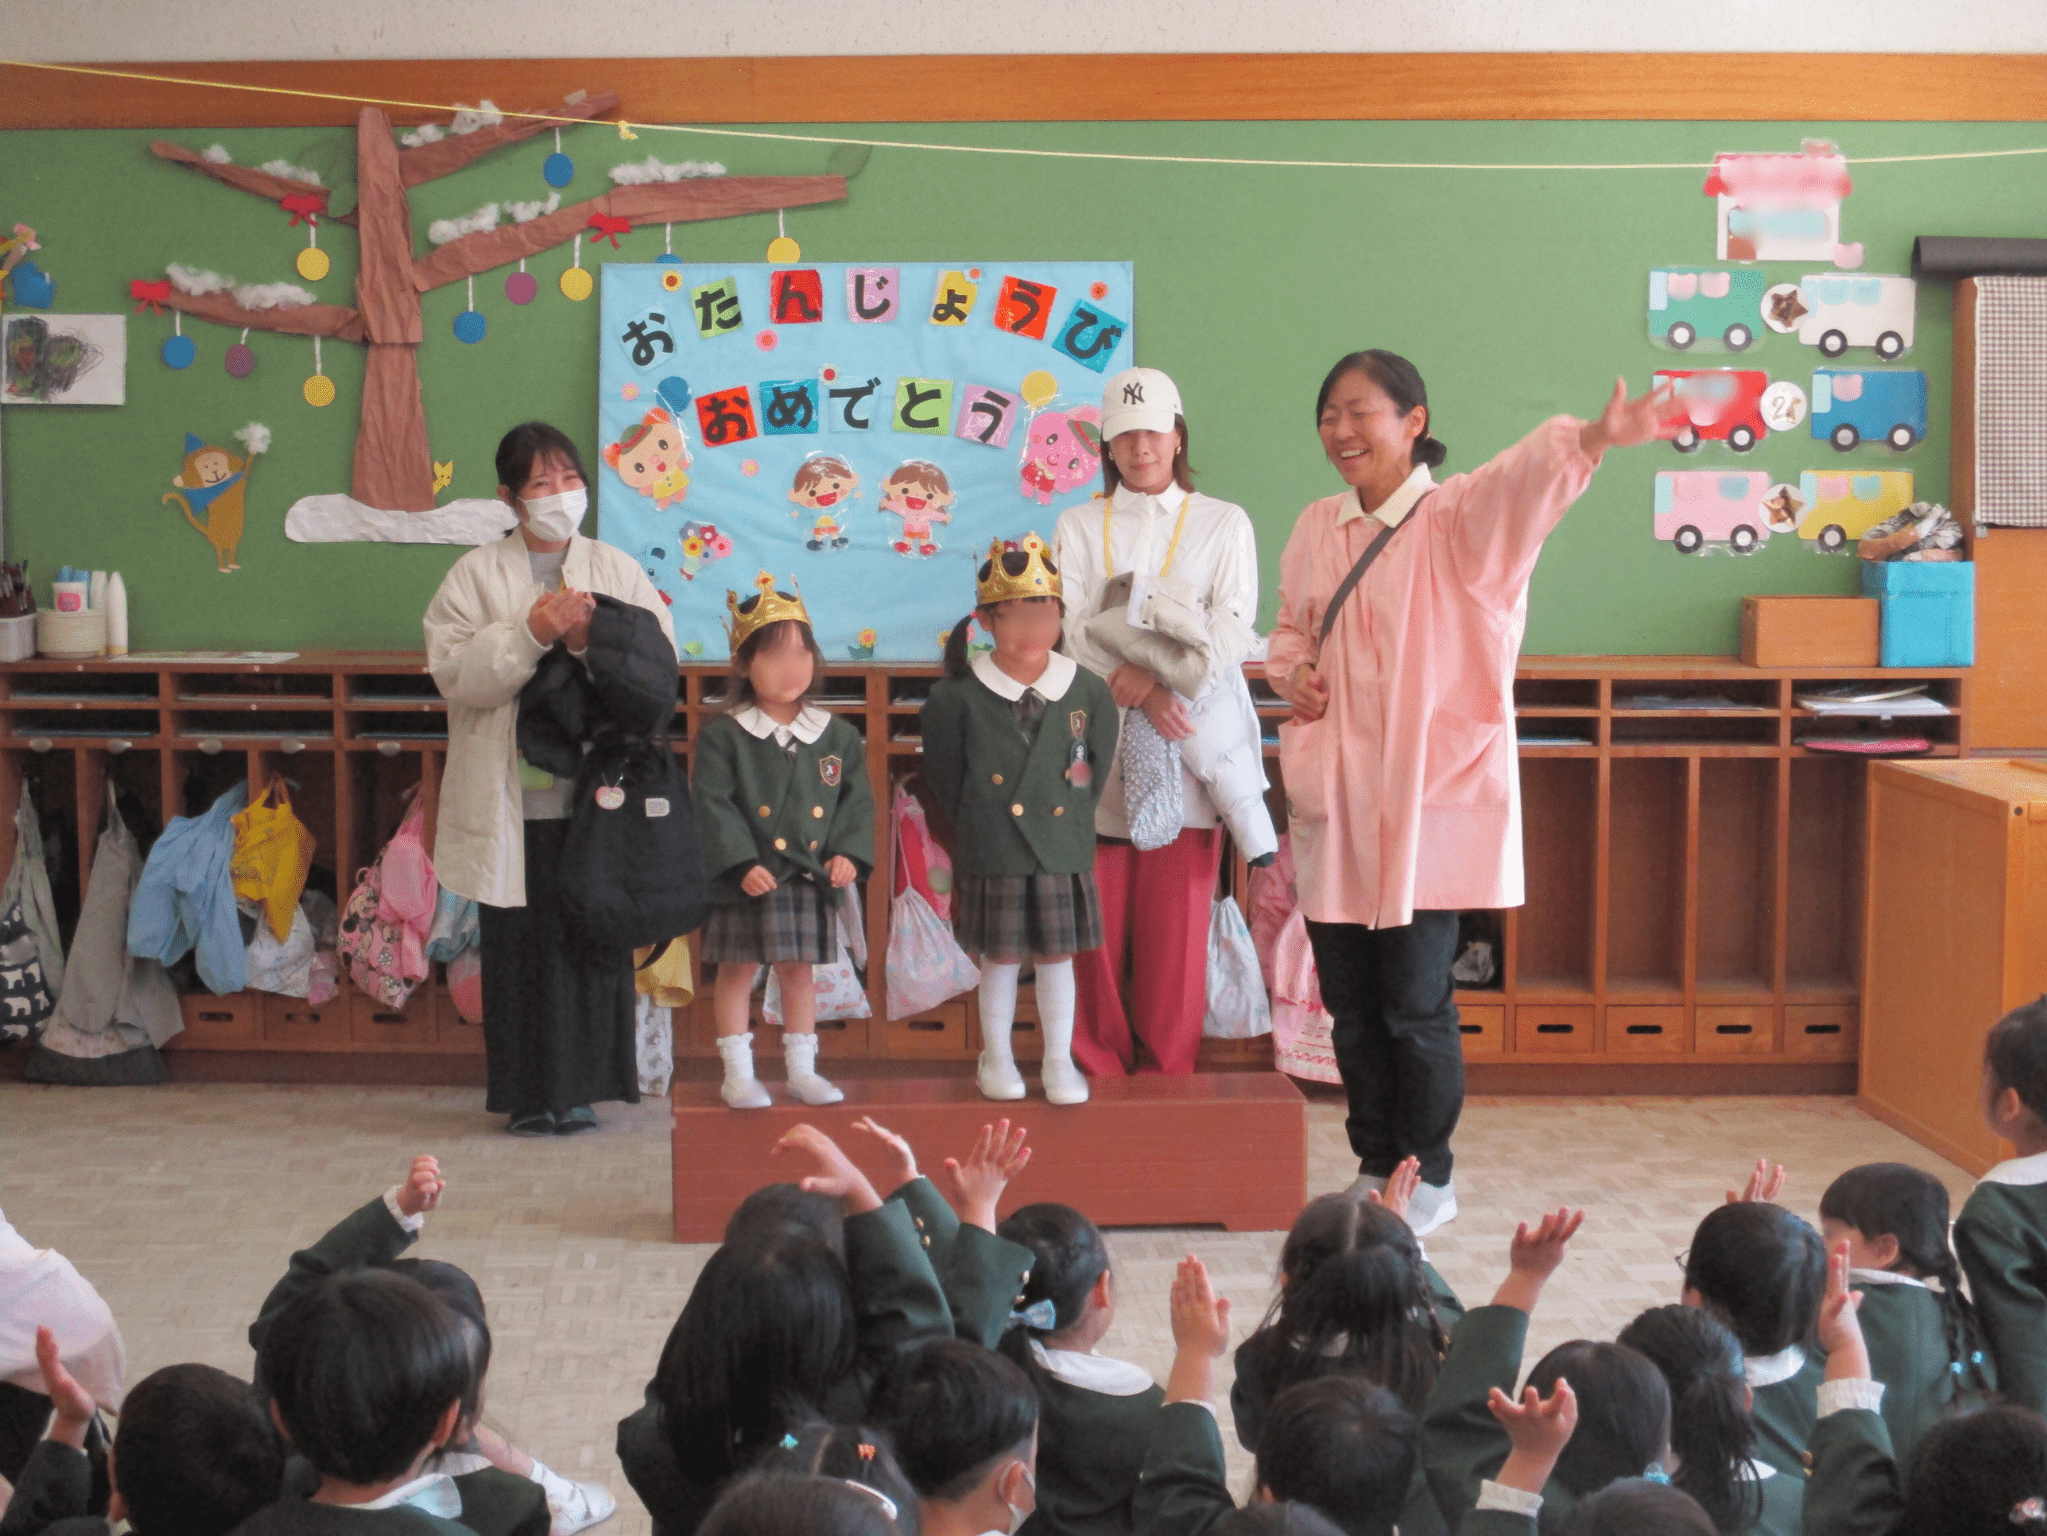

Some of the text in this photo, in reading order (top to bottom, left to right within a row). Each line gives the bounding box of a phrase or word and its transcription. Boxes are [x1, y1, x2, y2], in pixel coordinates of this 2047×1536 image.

[621, 271, 1123, 367] おたんじょうび
[704, 376, 1012, 445] おめでとう
[1123, 382, 1145, 405] NY
